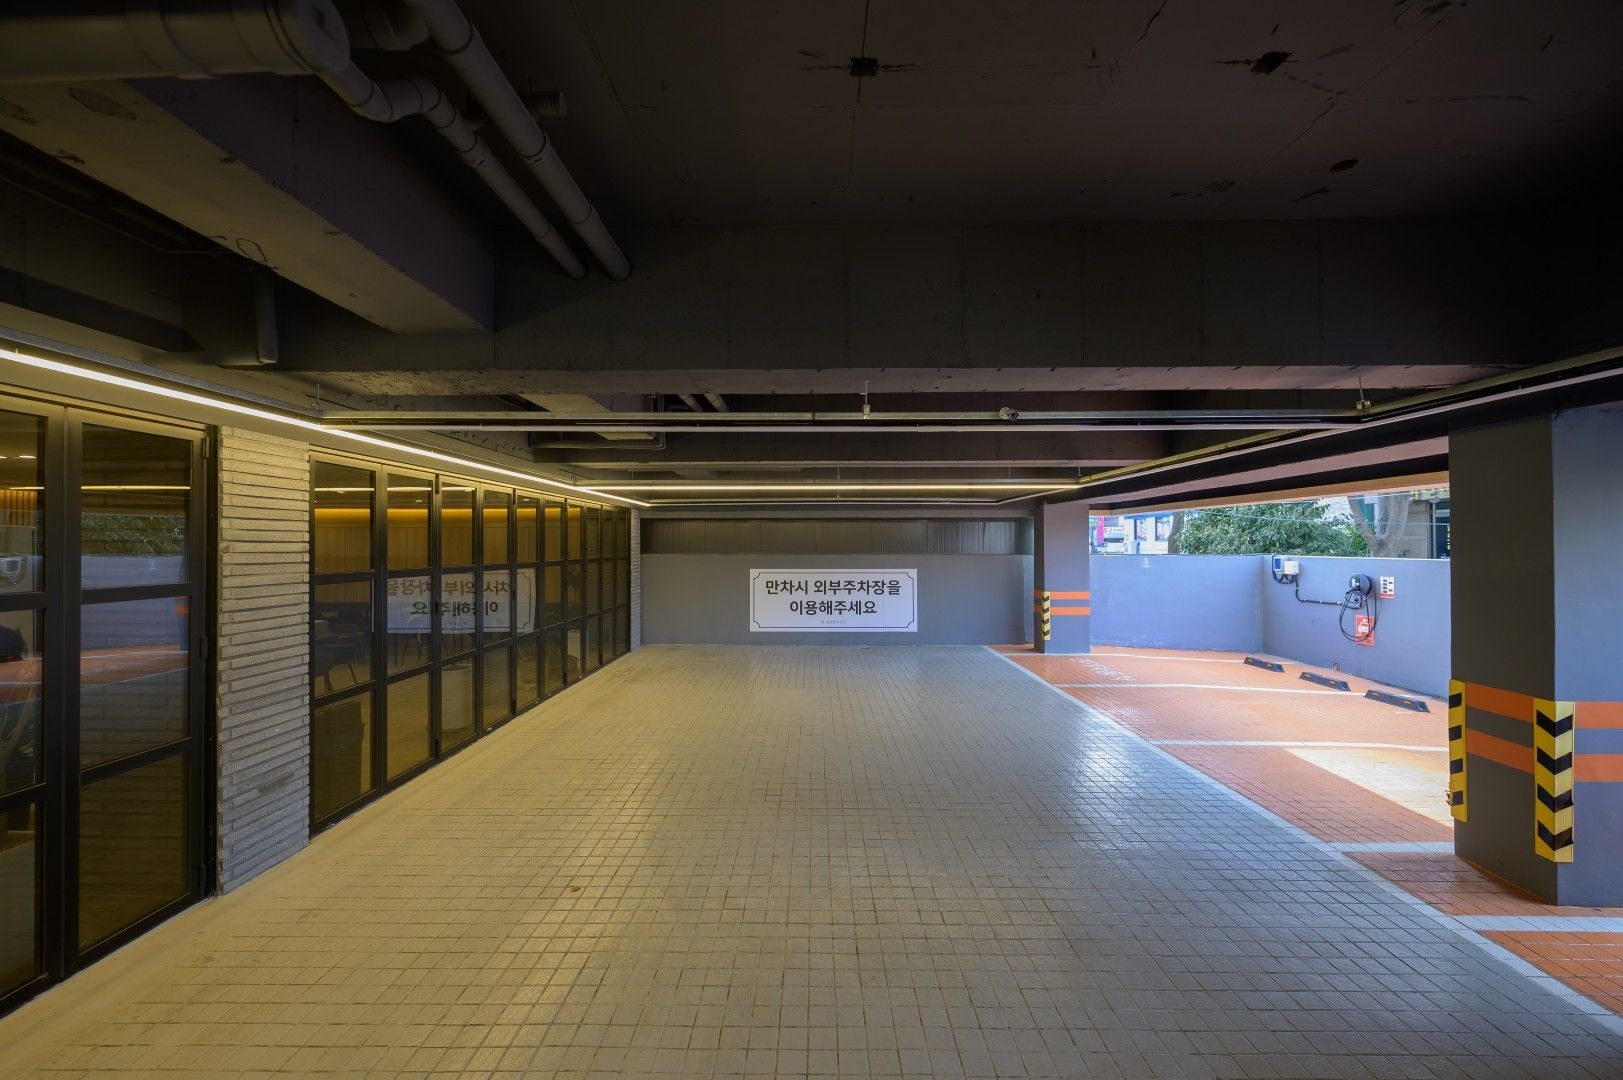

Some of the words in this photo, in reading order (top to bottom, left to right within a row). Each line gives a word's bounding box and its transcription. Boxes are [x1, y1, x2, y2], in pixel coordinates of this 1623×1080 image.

[765, 579, 808, 595] 만차시
[813, 579, 902, 596] 외부주차장을
[789, 600, 878, 616] 이용해주세요
